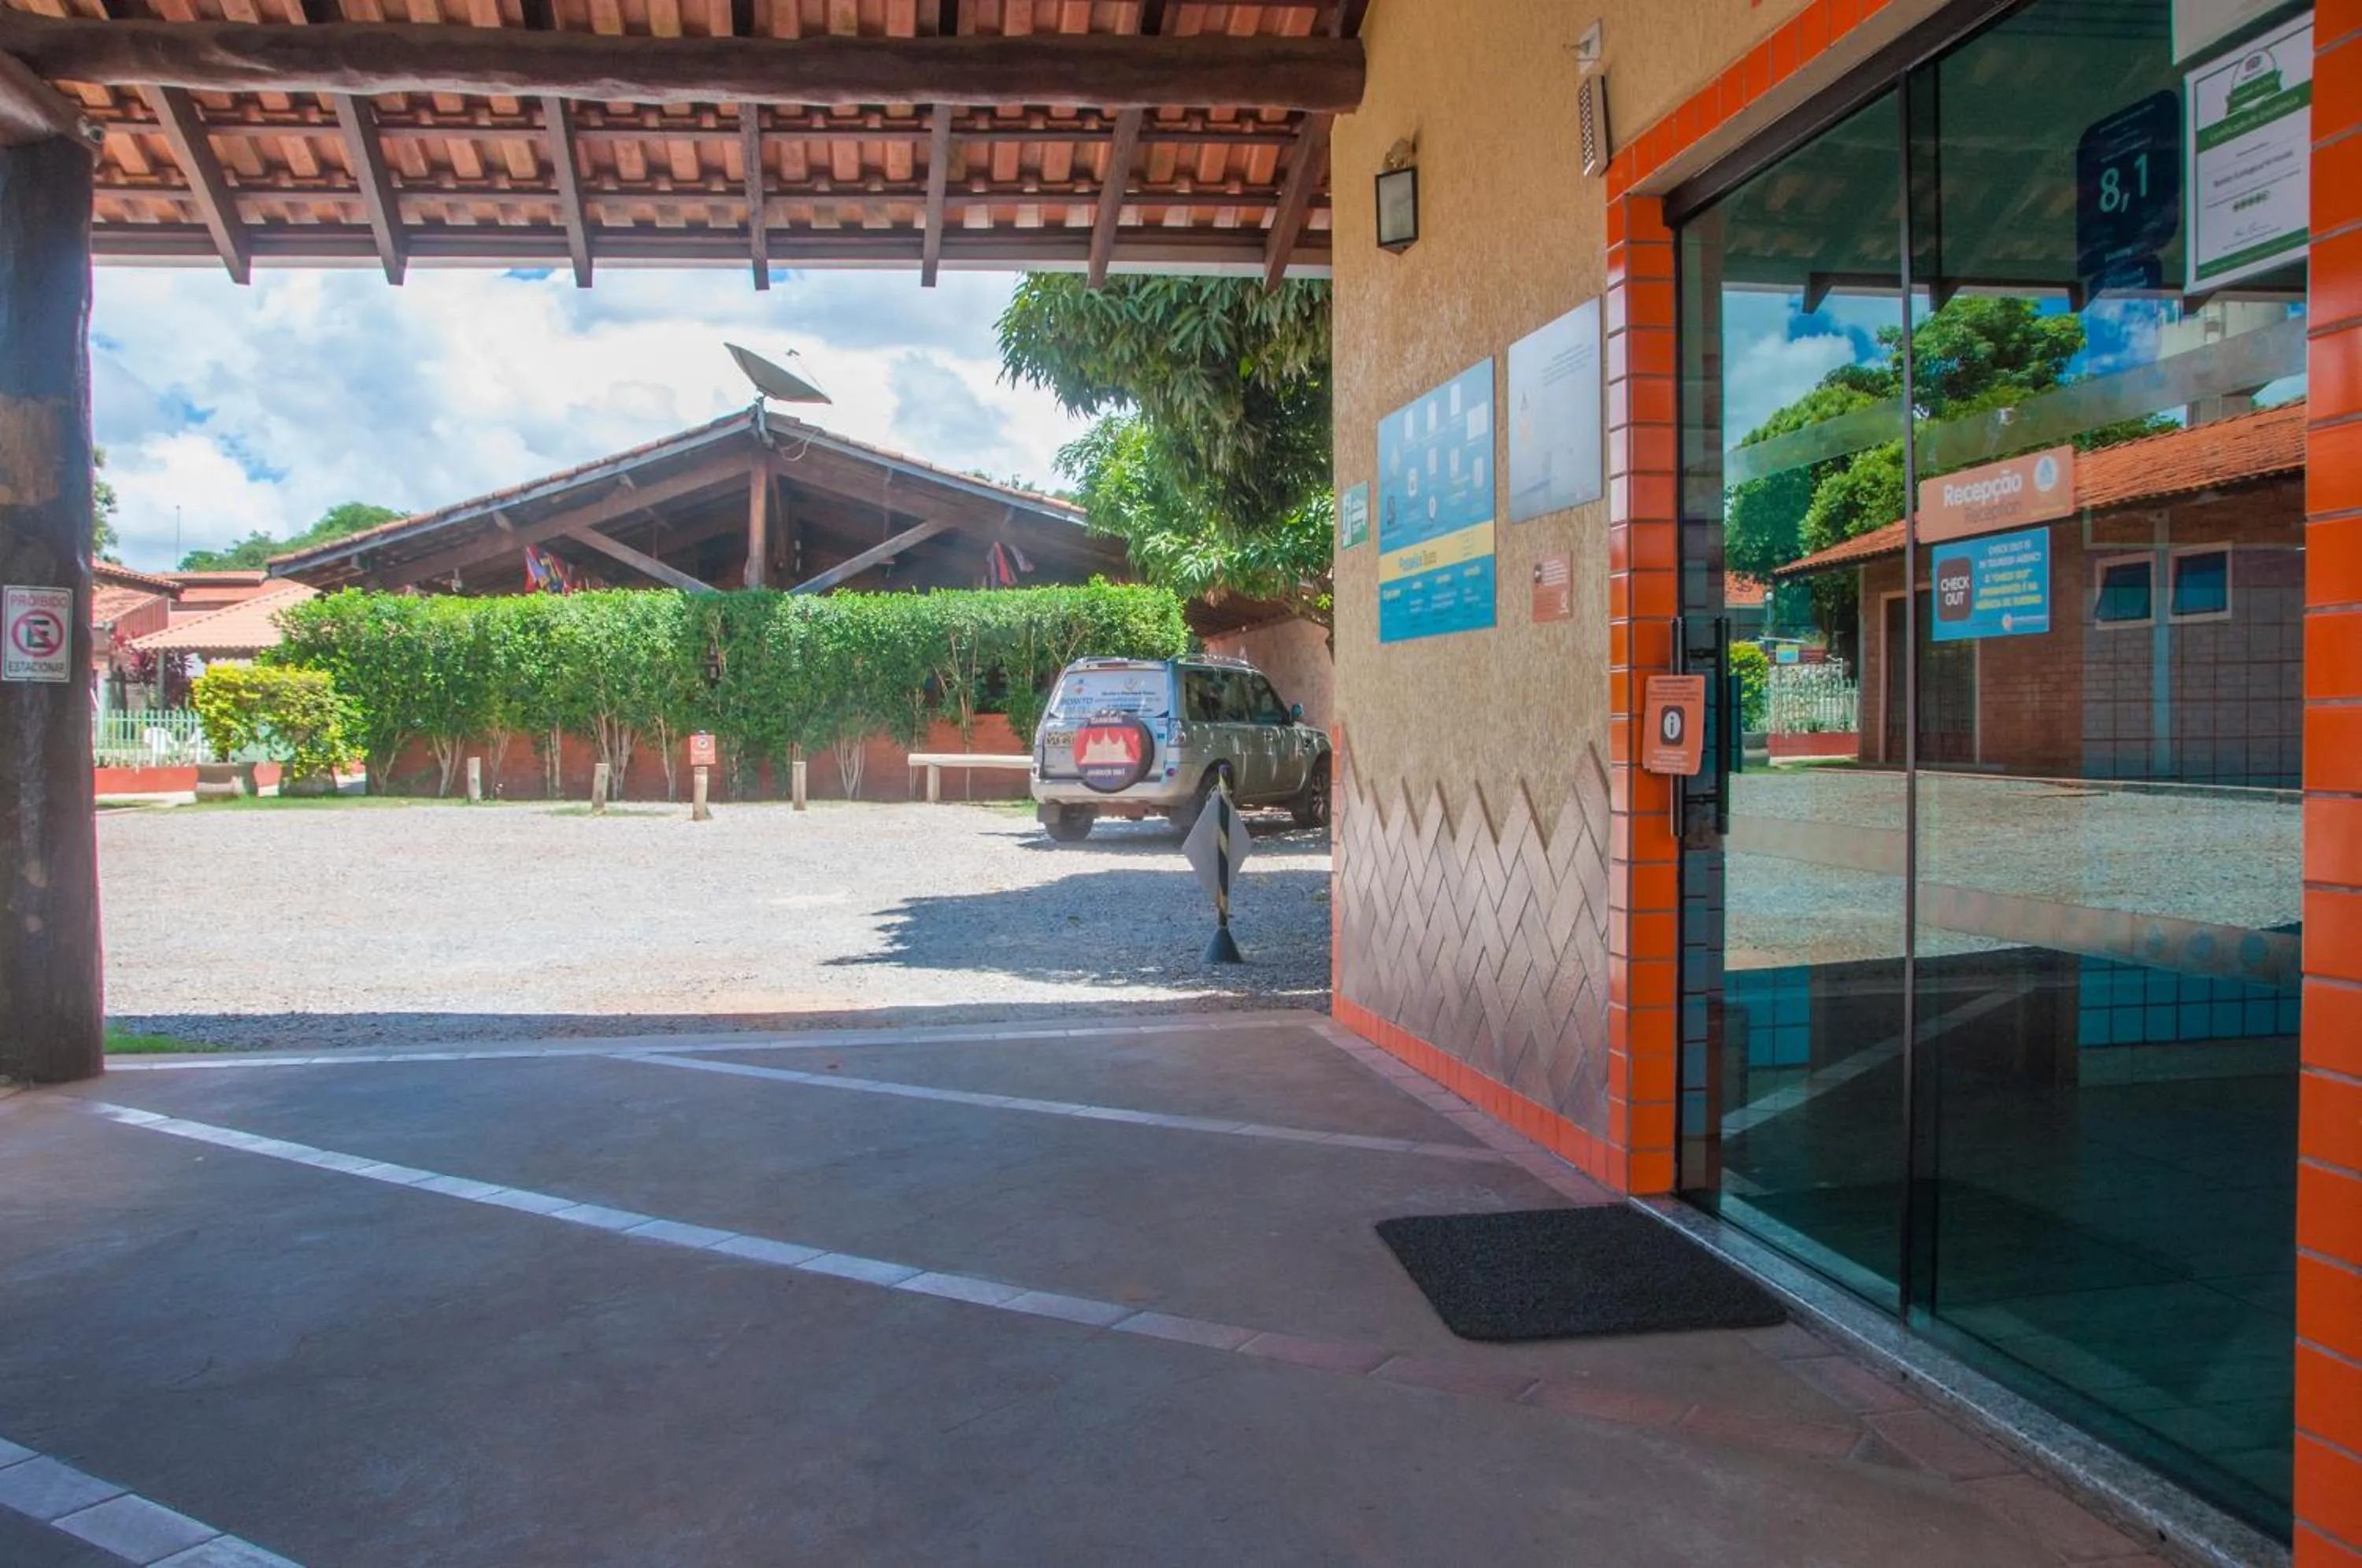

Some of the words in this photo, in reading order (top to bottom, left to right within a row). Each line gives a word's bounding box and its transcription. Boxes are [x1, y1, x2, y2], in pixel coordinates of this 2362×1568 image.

[2098, 152, 2149, 213] 8,1
[1943, 468, 2023, 508] Recepção
[1964, 501, 2022, 523] Reception
[1940, 576, 1970, 592] CHECK
[10, 594, 68, 608] PROIBIDO
[1945, 592, 1966, 607] OUT
[8, 660, 66, 675] ESTACIONAR
